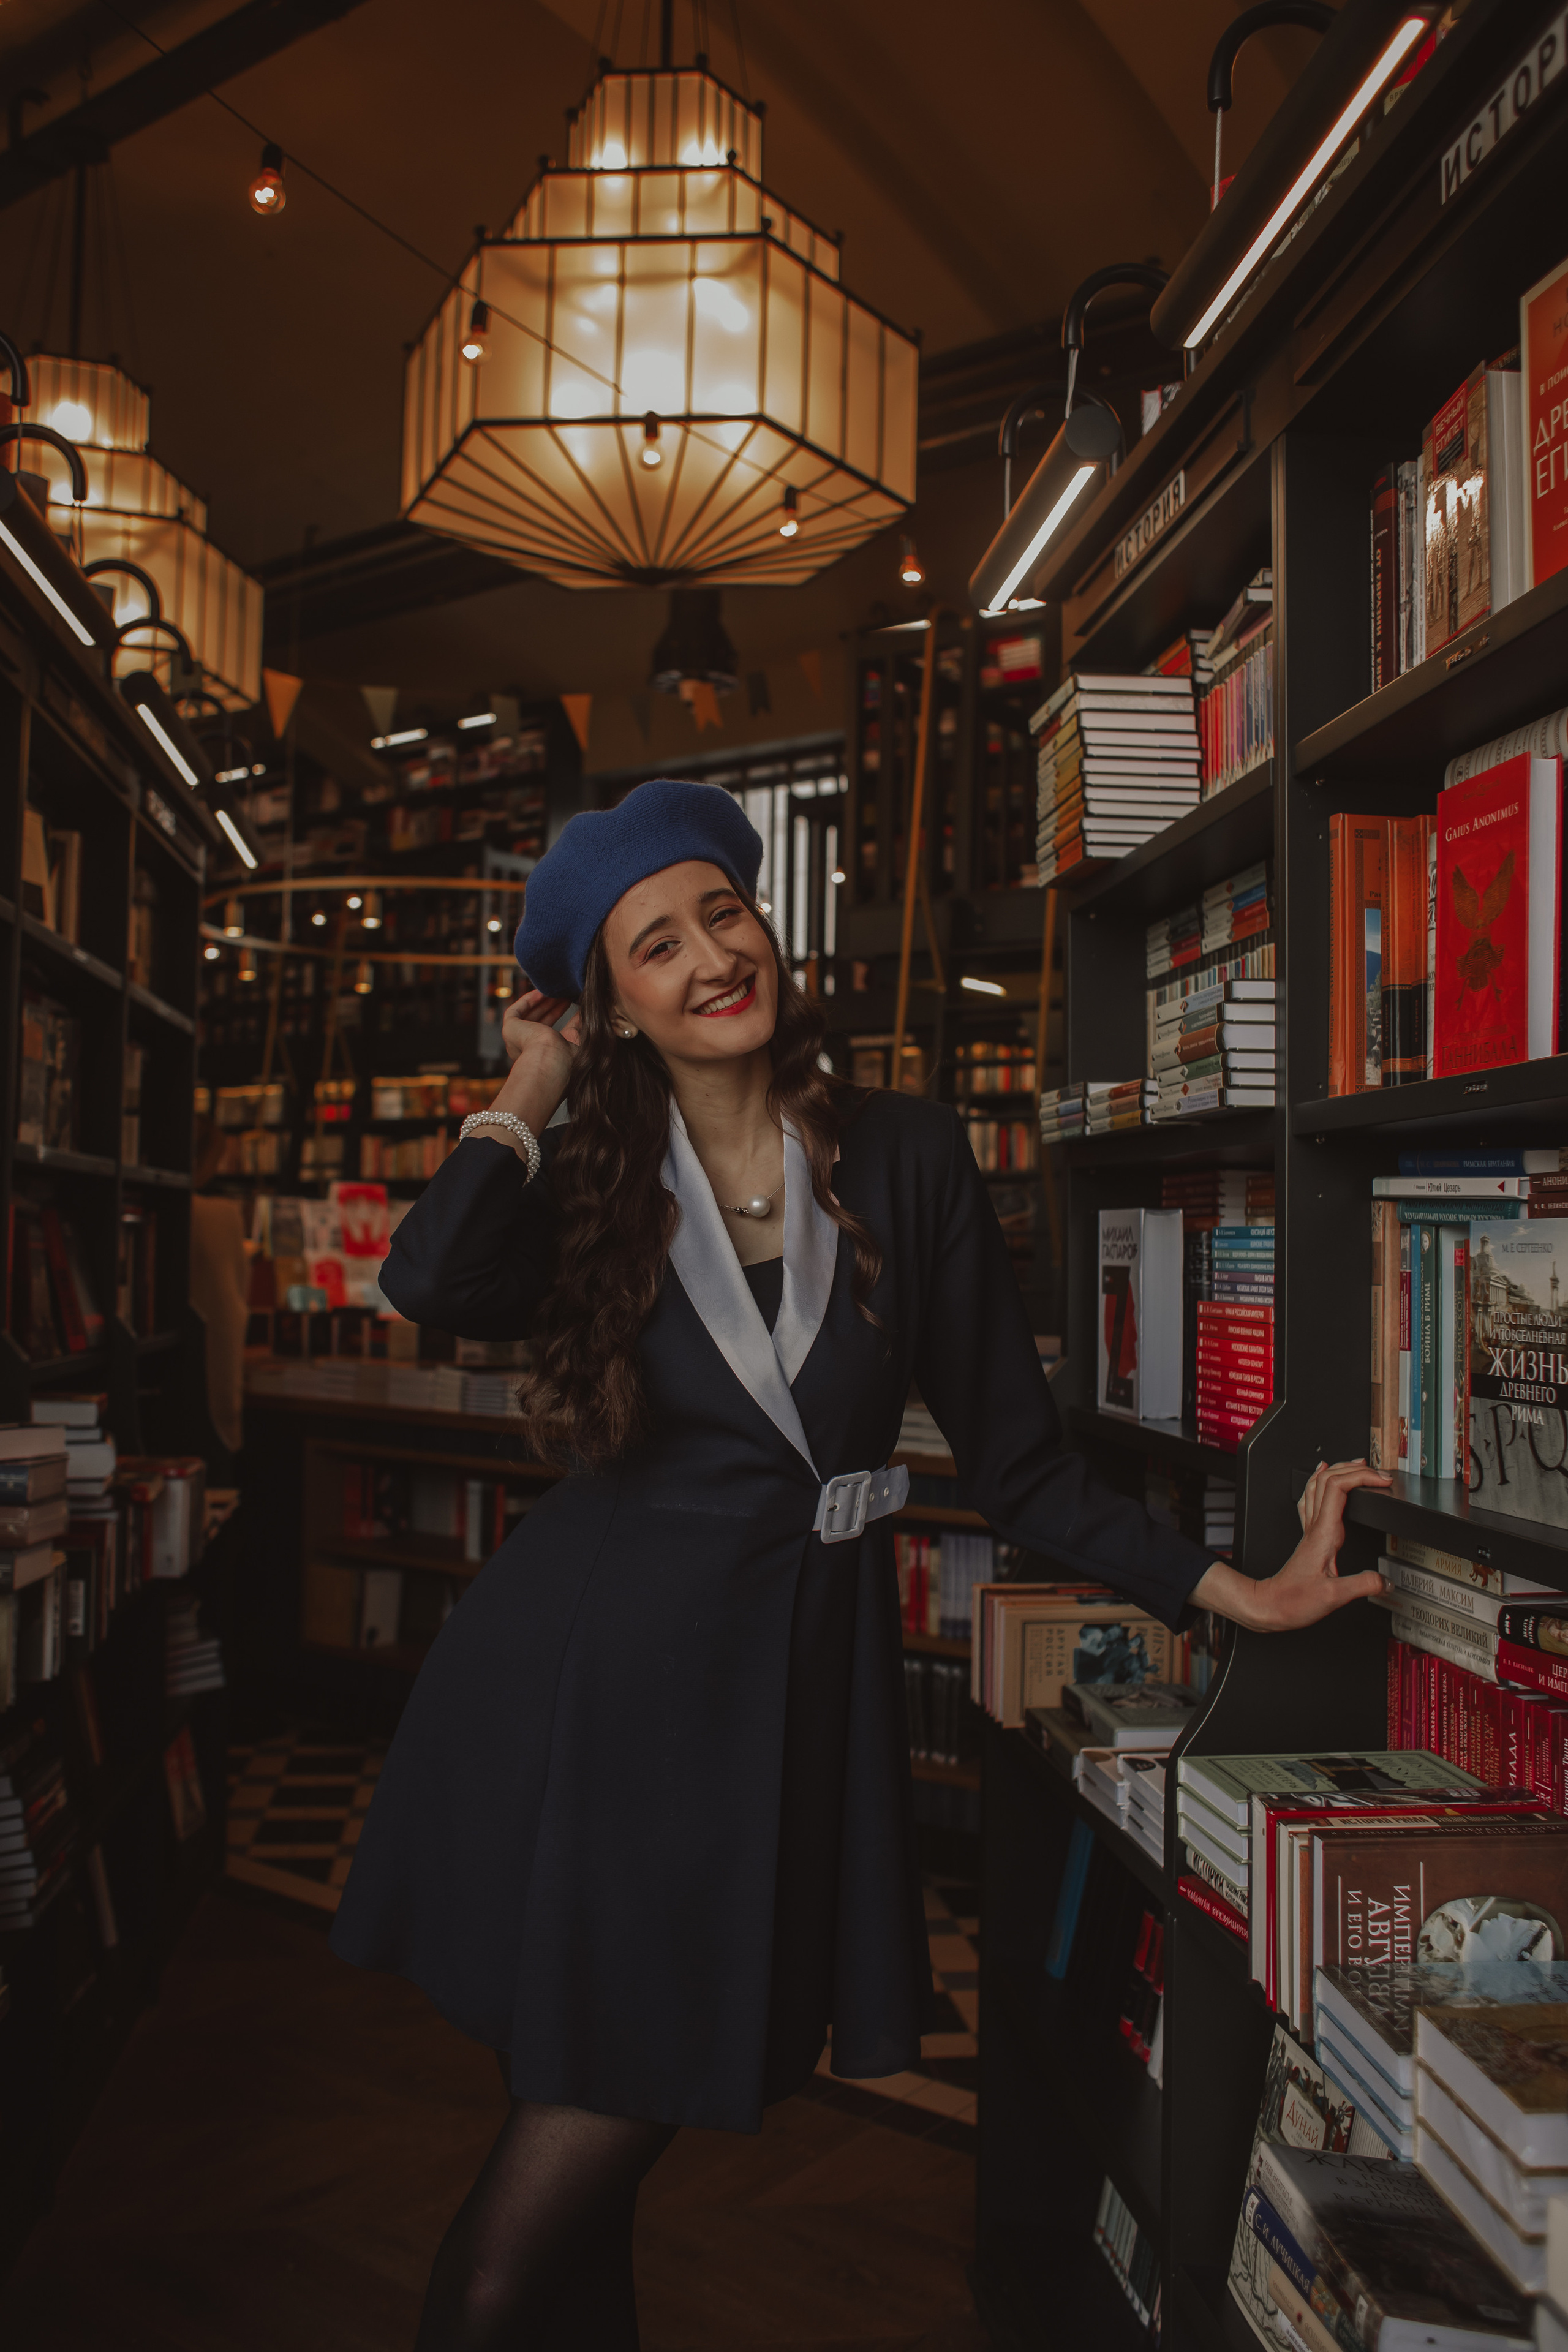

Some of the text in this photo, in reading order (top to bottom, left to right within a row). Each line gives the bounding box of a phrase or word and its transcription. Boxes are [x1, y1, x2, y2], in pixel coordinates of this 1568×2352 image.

[1444, 15, 1568, 203] ИСТОР
[1436, 396, 1464, 436] ВЕЧНЫЙ
[1533, 395, 1568, 452] ДРЕ
[1436, 415, 1464, 454] ЕГИПЕТ
[1115, 478, 1180, 577] ИСТОРИЯ
[1376, 548, 1382, 568] ОТ
[1376, 641, 1382, 652] К
[1446, 801, 1520, 842] GAIUS ANONIMUS
[1442, 1035, 1519, 1071] ГАННИБАЛА
[1428, 1182, 1461, 1194] Юлий Цезарь
[1404, 1212, 1439, 1221] ПРИНЦИПАТА
[1439, 1213, 1458, 1221] ЭПОХИ
[1493, 1311, 1562, 1328] ПРОСТЫЕ ЛЮДИ
[1490, 1328, 1567, 1346] И ПОВСЕДНЕВНАЯ
[1487, 1347, 1568, 1384] ЖИЗНЬ
[1499, 1381, 1558, 1404] ДРЕВНЕГО
[1512, 1404, 1545, 1425] РИМА
[1436, 1556, 1462, 1577] АРМИЯ
[1401, 1570, 1474, 1610] ВАЛЕРИЙ МАКСИМ
[1411, 1605, 1449, 1634] ТЕОДОРИХ
[1451, 1621, 1488, 1649] ВЕЛИКИЙ
[1513, 1661, 1534, 1673] ВАСИЛИК
[1552, 1664, 1568, 1679] ЦЕР
[1539, 1673, 1568, 1695] И ИМП
[1509, 1732, 1518, 1786] ИАДА
[1341, 1816, 1391, 1825] ИСТОРИЯ
[1394, 1815, 1430, 1825] РИМА
[1525, 1823, 1568, 1832] АВГУС
[1186, 1888, 1249, 1939] ИЗАНТИЙСКАЯ КУЛЬТУРА
[1348, 1889, 1362, 1949] И ЕГО
[1365, 1896, 1392, 1966] АВГУ
[1286, 2100, 1319, 2148] ДУНАЙ
[1264, 2160, 1274, 2176] ВЕКА
[1299, 2150, 1389, 2176] ЖАК
[1273, 2172, 1289, 2202] СРЕДНИЕ
[1336, 2176, 1348, 2185] В
[1360, 2173, 1429, 2190] ГОРОД
[1333, 2192, 1345, 2201] В
[1255, 2214, 1311, 2294] С. И. ЛУЧИЦКАЯ
